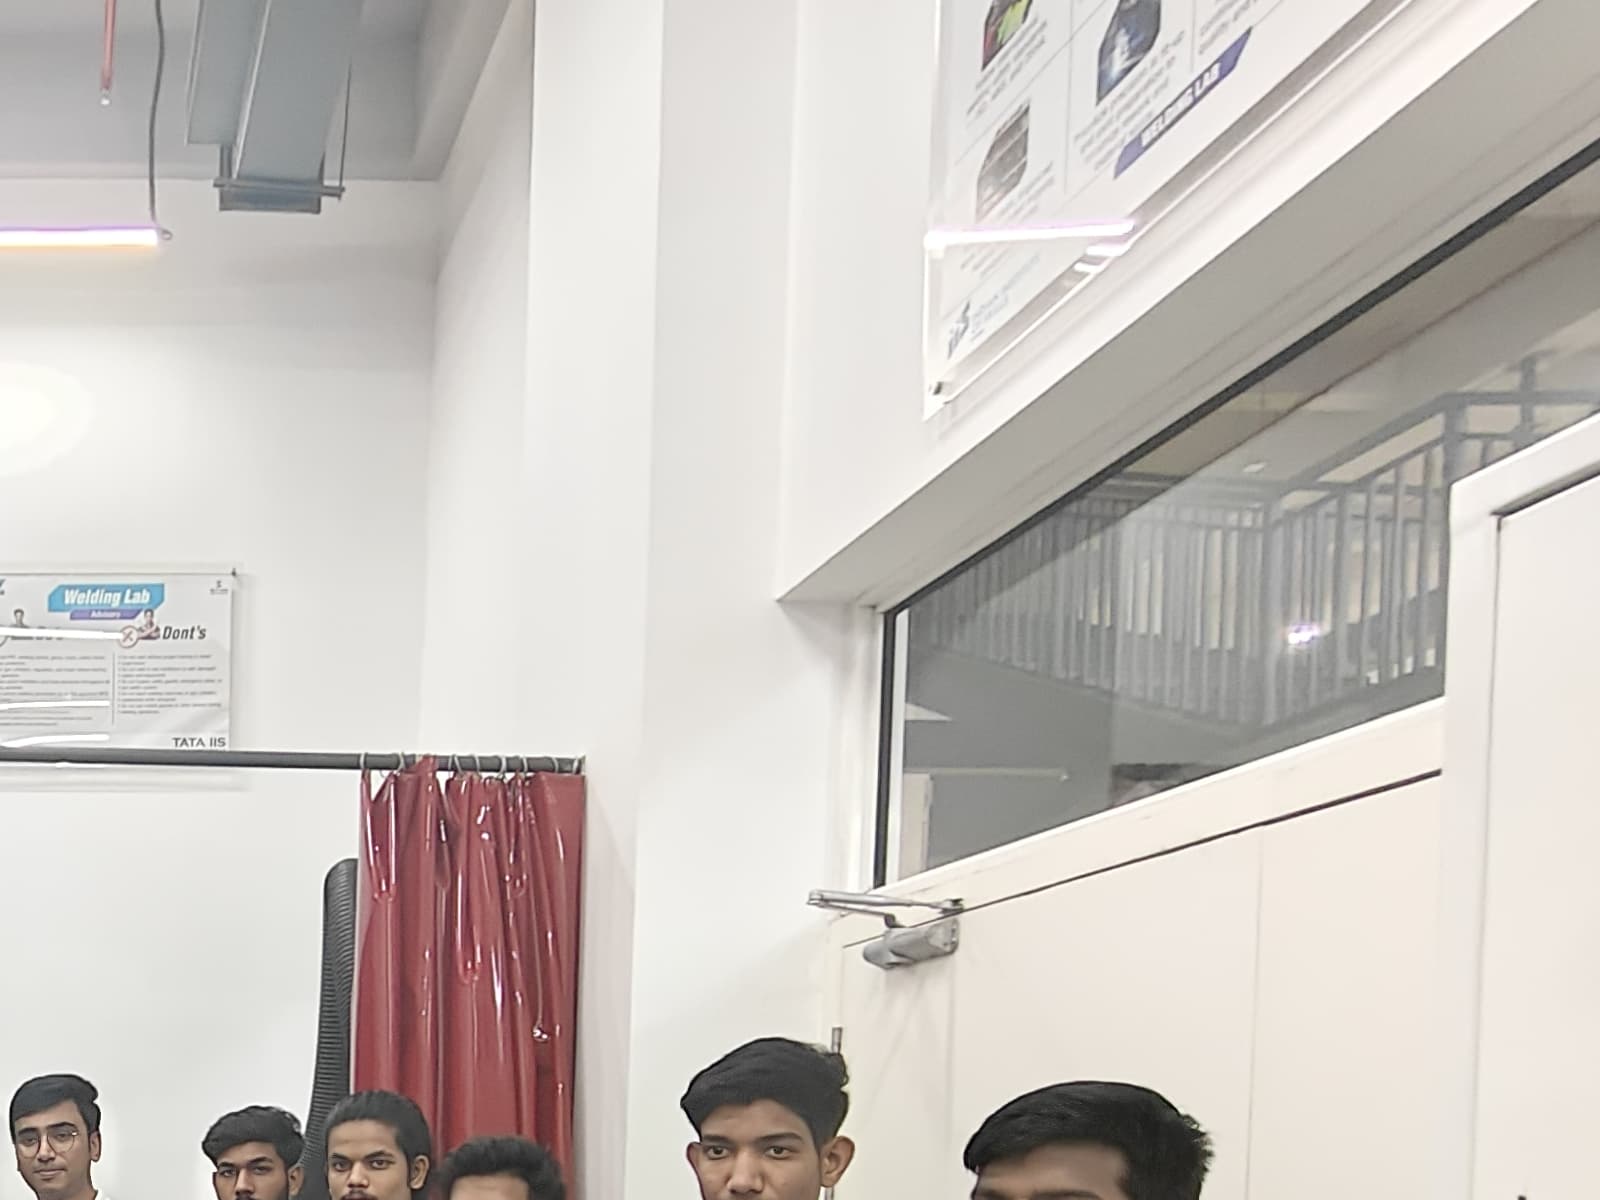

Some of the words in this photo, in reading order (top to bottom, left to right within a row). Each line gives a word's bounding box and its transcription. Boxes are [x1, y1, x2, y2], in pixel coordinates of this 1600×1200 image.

[64, 588, 122, 607] Welding
[124, 588, 151, 604] Lab
[162, 625, 207, 640] Dont's
[171, 737, 206, 748] TATA
[209, 737, 226, 748] IIS
